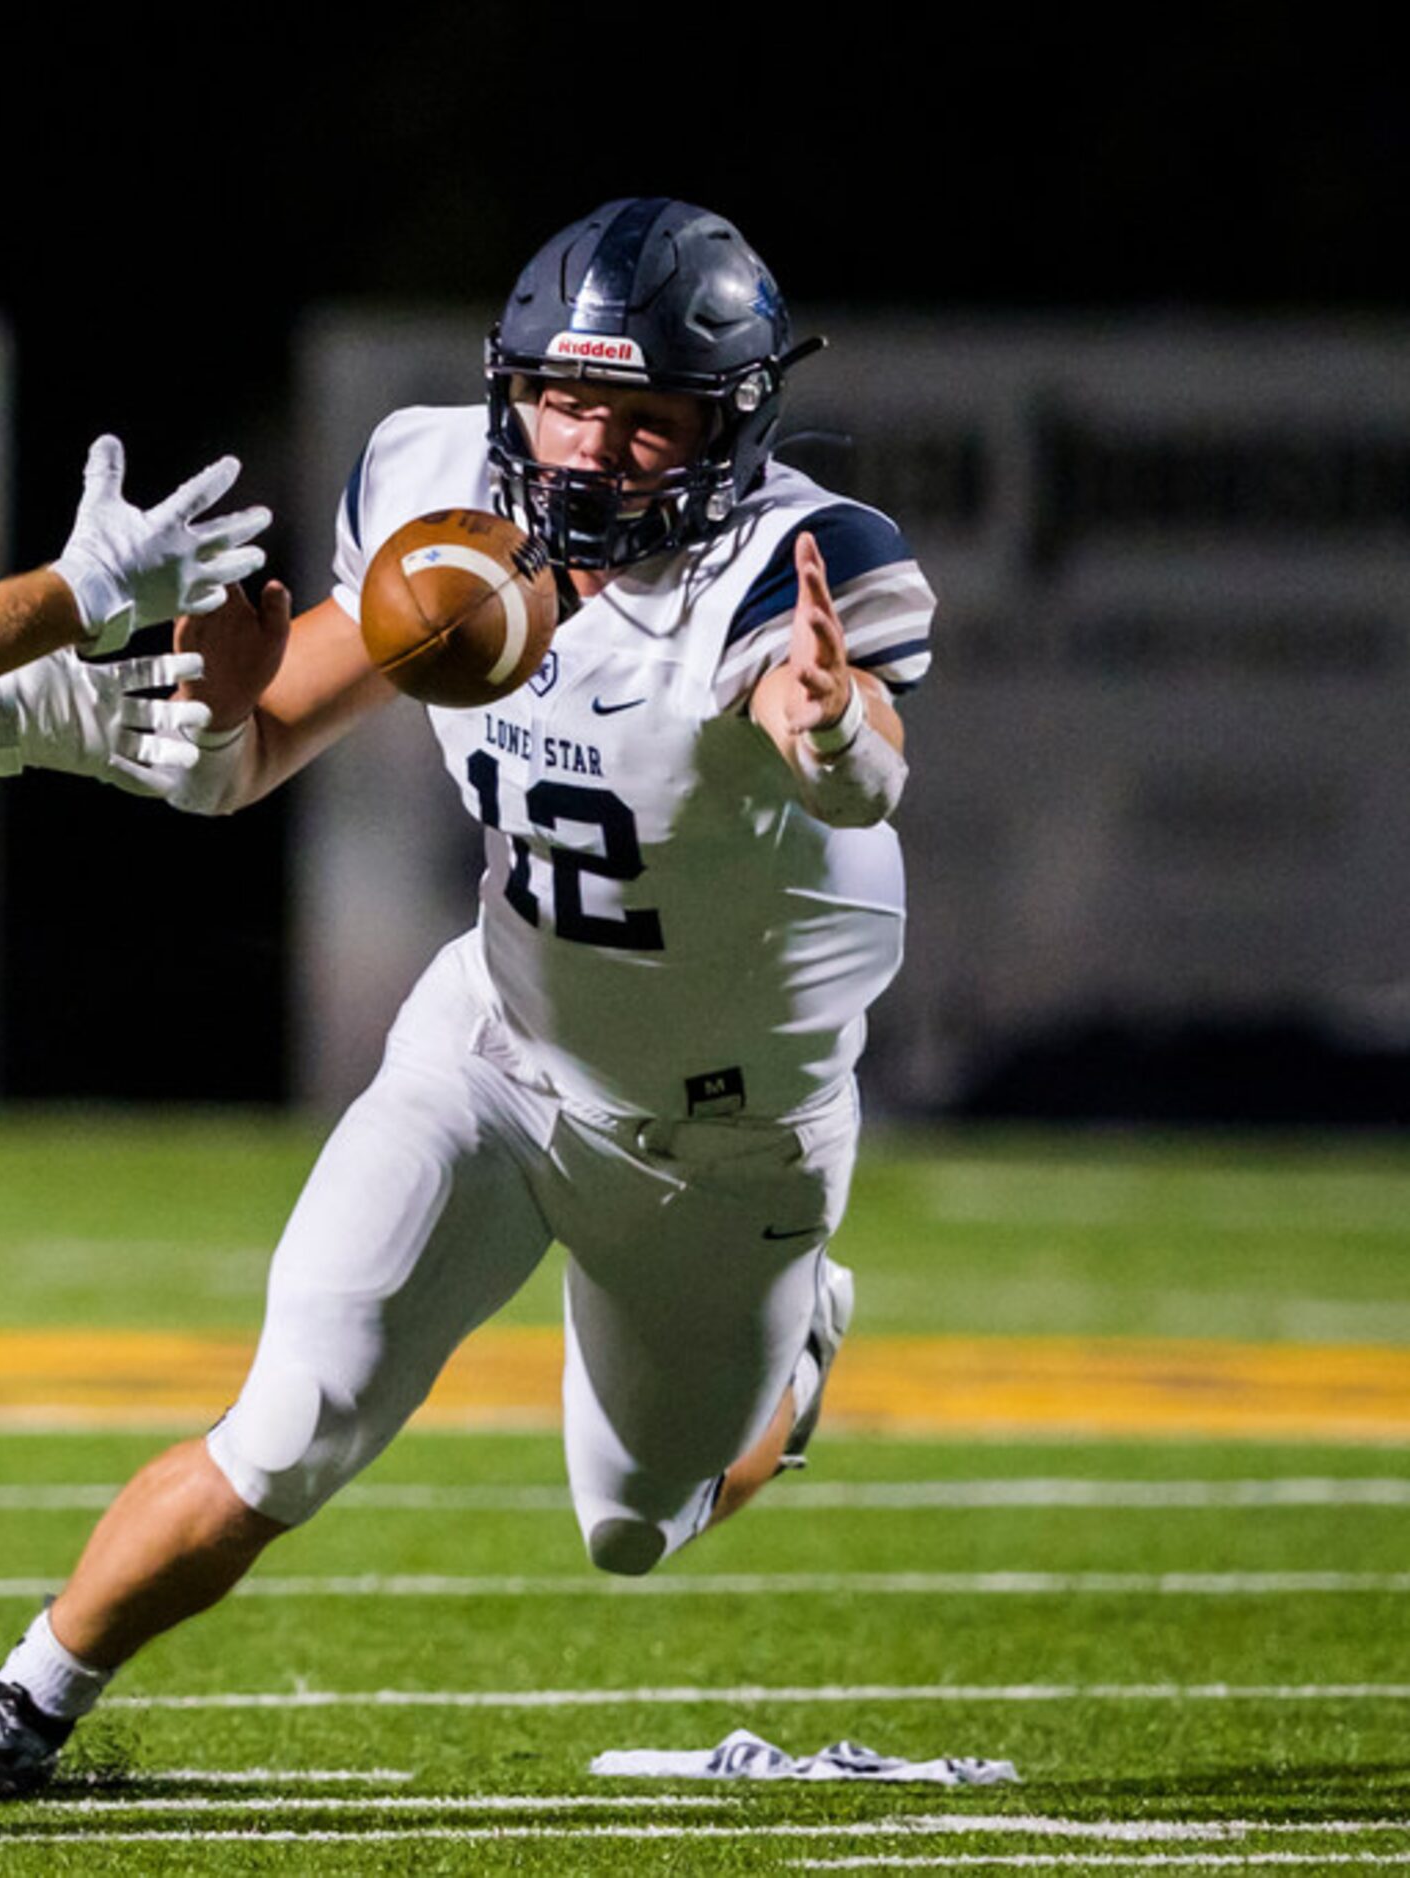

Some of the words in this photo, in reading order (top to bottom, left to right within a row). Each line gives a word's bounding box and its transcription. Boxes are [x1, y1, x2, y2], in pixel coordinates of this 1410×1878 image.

[557, 340, 633, 360] Riddell
[484, 712, 532, 761] LONE
[543, 736, 604, 777] STAR
[466, 748, 666, 951] 12
